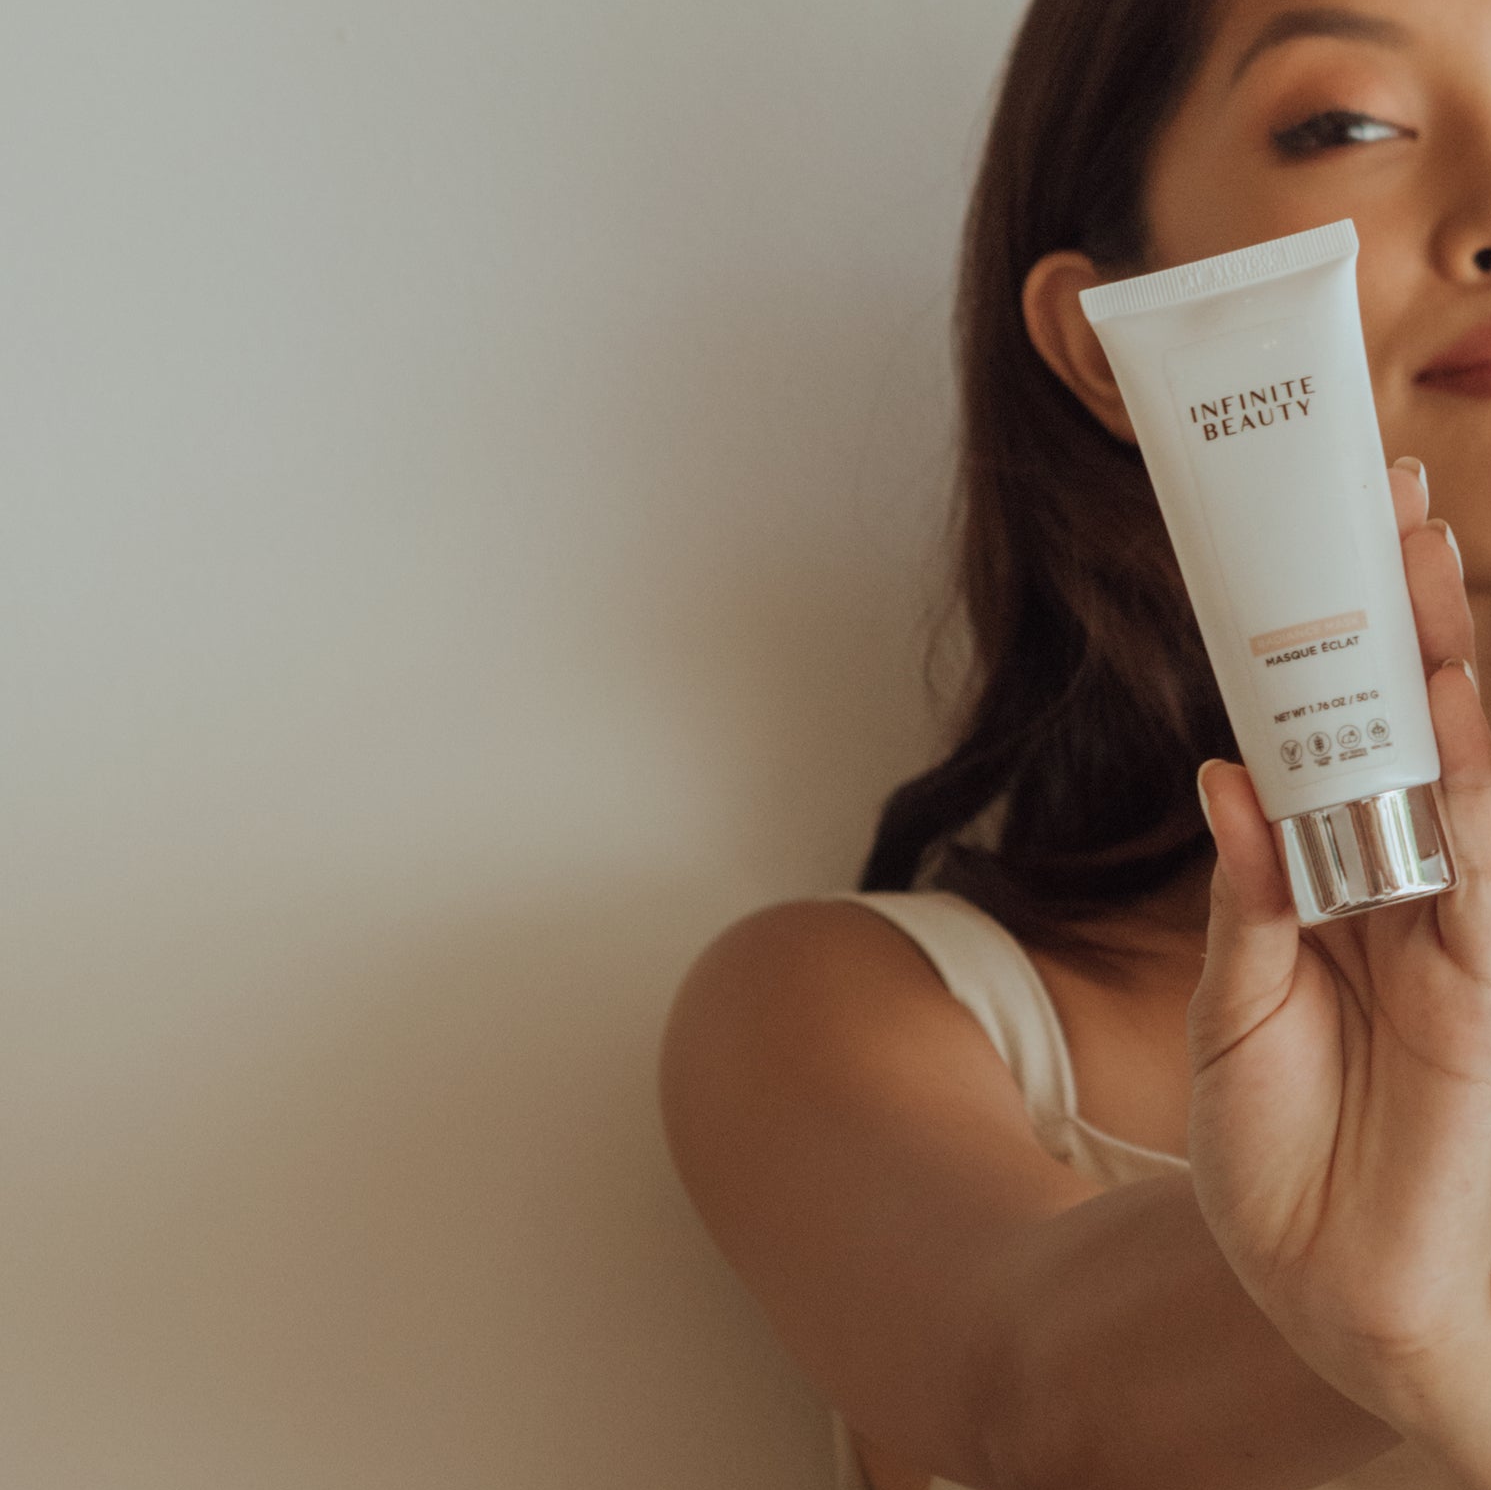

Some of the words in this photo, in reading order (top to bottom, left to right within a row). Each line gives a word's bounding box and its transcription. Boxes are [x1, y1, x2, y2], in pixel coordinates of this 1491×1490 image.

[1190, 376, 1316, 423] INFINITE
[1203, 398, 1310, 441] BEAUTY
[1265, 646, 1318, 667] MASQUE
[1321, 635, 1359, 653] ÉCLAT
[1274, 712, 1290, 723] NET
[1292, 707, 1306, 718] WT
[1332, 697, 1346, 708] OZ
[1357, 692, 1369, 702] 50
[1370, 690, 1379, 699] G
